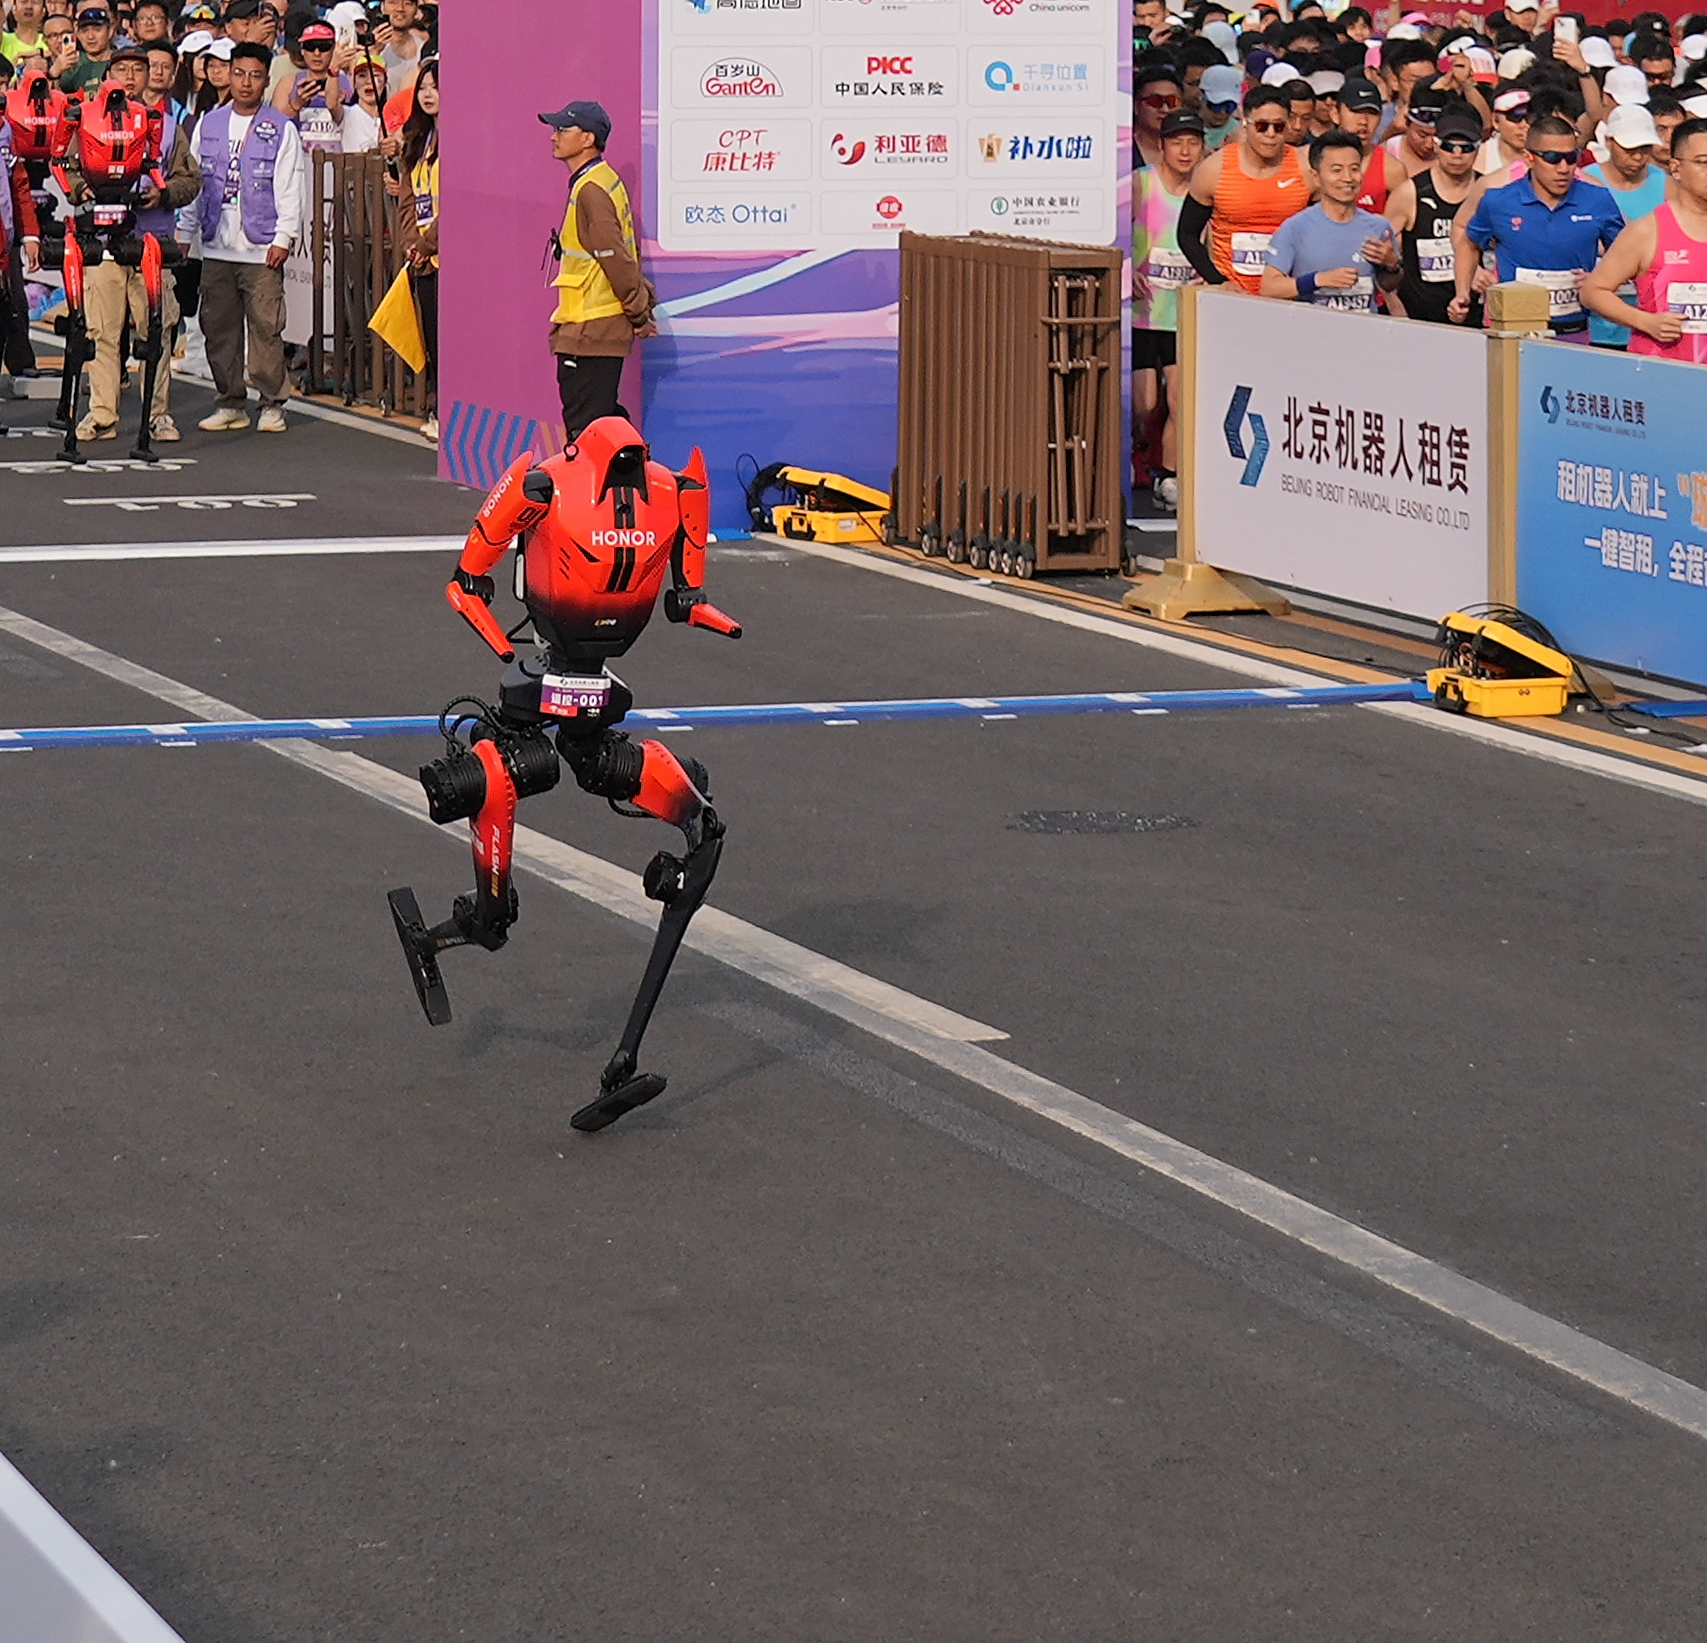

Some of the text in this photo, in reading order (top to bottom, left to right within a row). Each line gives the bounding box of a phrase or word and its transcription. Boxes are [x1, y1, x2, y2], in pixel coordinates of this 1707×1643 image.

[1029, 3, 1055, 12] China
[715, 64, 760, 77] 百岁山
[867, 56, 913, 75] PICC
[1024, 63, 1087, 80] 千寻位置
[835, 81, 944, 97] 中国人民保险
[100, 131, 135, 140] HONOR
[718, 129, 768, 149] CPT
[874, 134, 948, 153] 利亚德
[1009, 135, 1092, 160] 补水啦
[702, 151, 777, 171] 康比特
[685, 204, 788, 223] 欧态 Ottai
[1564, 390, 1646, 426] 北京机器人租赁
[1282, 395, 1470, 496] 北京机器人租赁
[483, 474, 513, 519] HONOR
[1281, 473, 1313, 497] BEIJING
[1315, 480, 1344, 504] ROBOT
[1348, 488, 1392, 514] FINANCIAL
[1395, 497, 1433, 523] LEASING
[1557, 459, 1668, 520] 租机器人就上
[591, 530, 656, 547] HONOR
